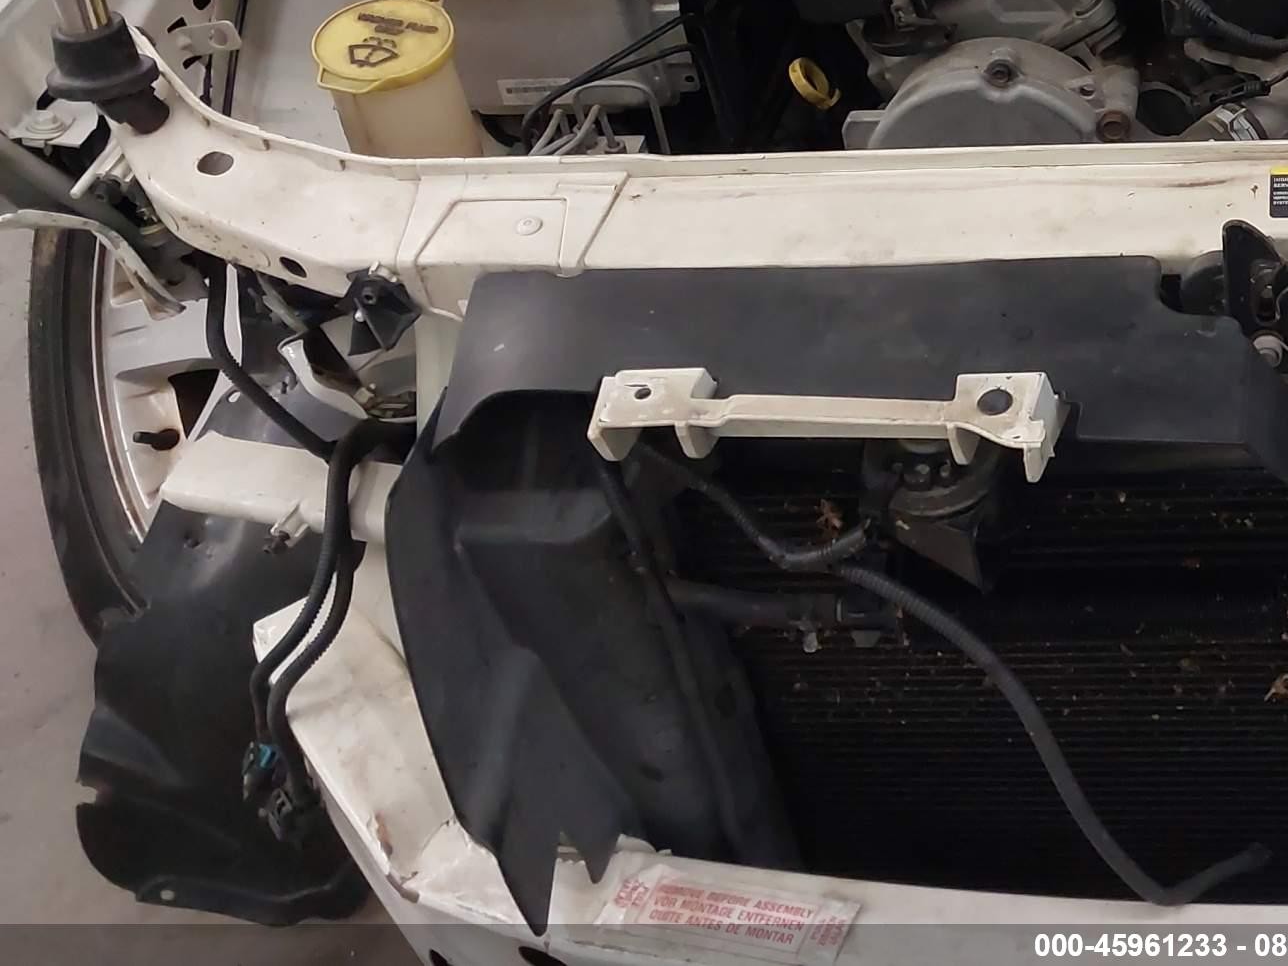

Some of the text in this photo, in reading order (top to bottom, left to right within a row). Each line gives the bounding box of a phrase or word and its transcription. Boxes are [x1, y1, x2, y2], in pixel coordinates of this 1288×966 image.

[679, 898, 734, 919] MONTAGE
[736, 909, 805, 932] ENTFERNEN
[753, 899, 814, 919] ASSEMBLY
[725, 923, 741, 936] DE
[744, 925, 796, 945] MONTAR
